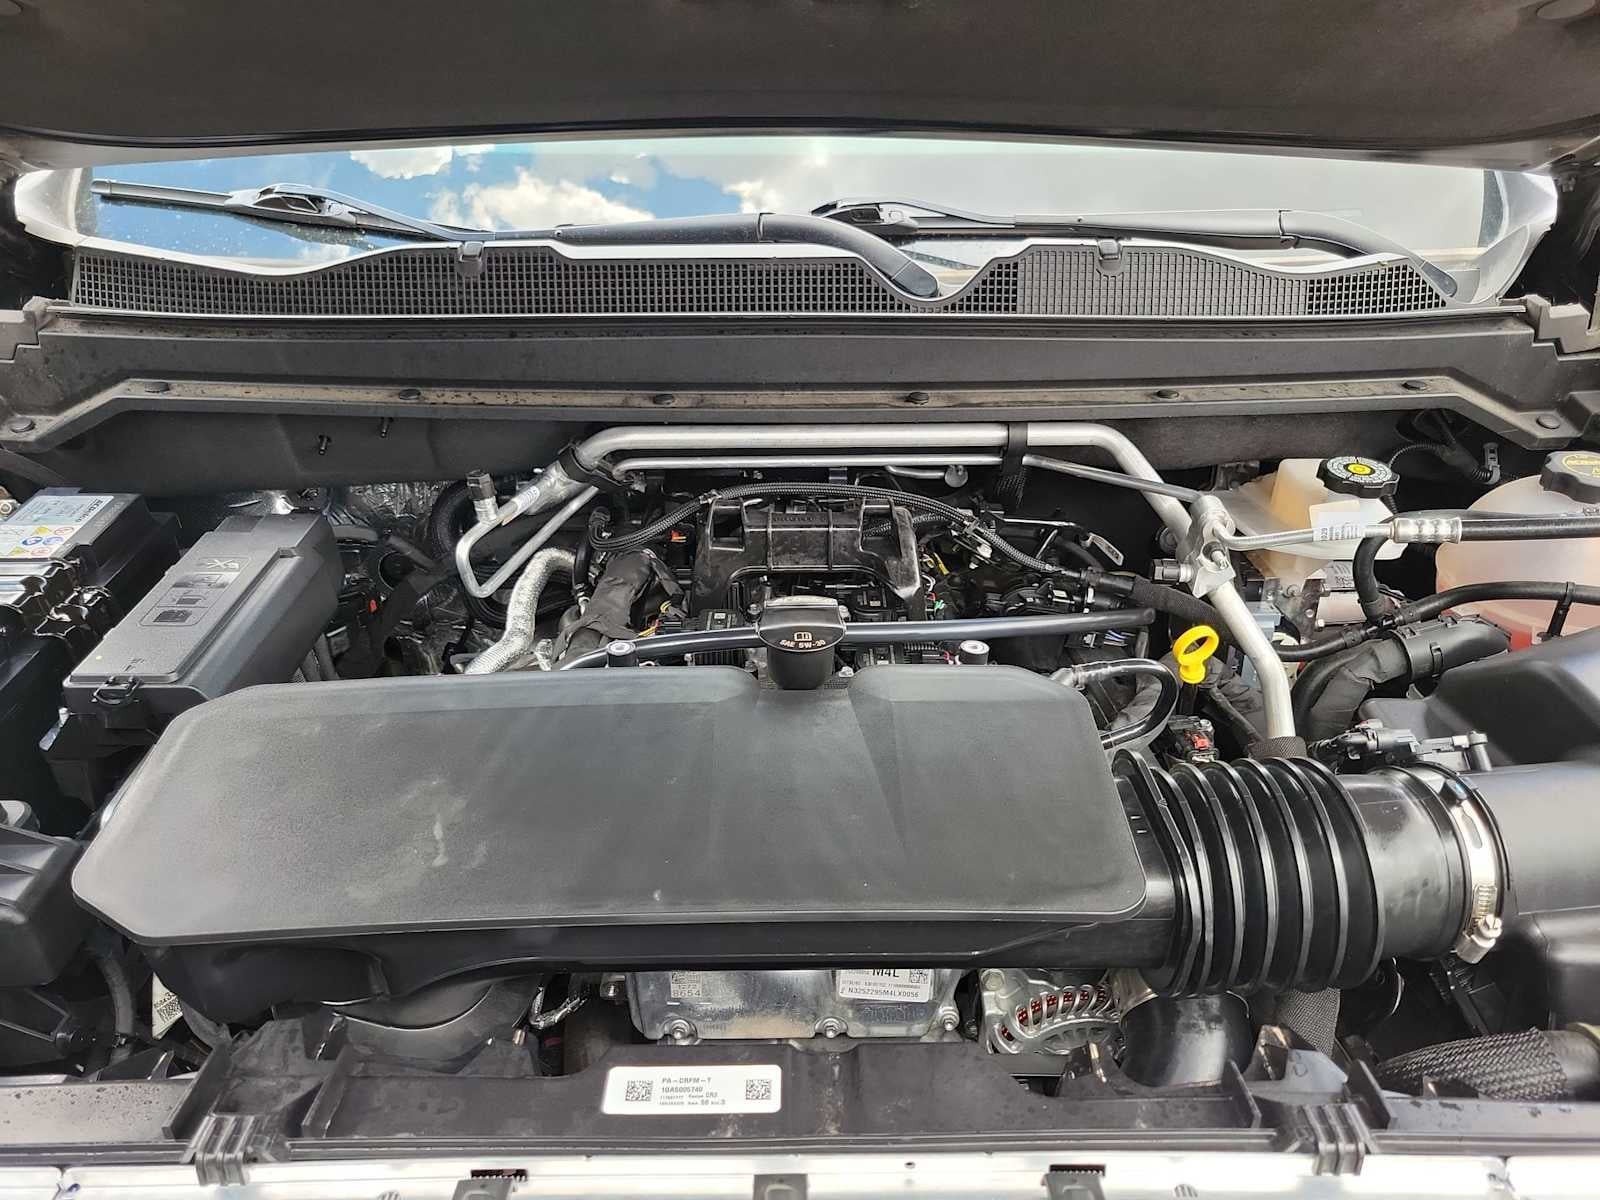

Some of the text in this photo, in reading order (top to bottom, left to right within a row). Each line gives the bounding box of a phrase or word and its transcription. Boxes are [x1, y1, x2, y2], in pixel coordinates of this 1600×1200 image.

[779, 639, 796, 648] SAE
[872, 968, 900, 978] M4L
[672, 989, 701, 997] 8654
